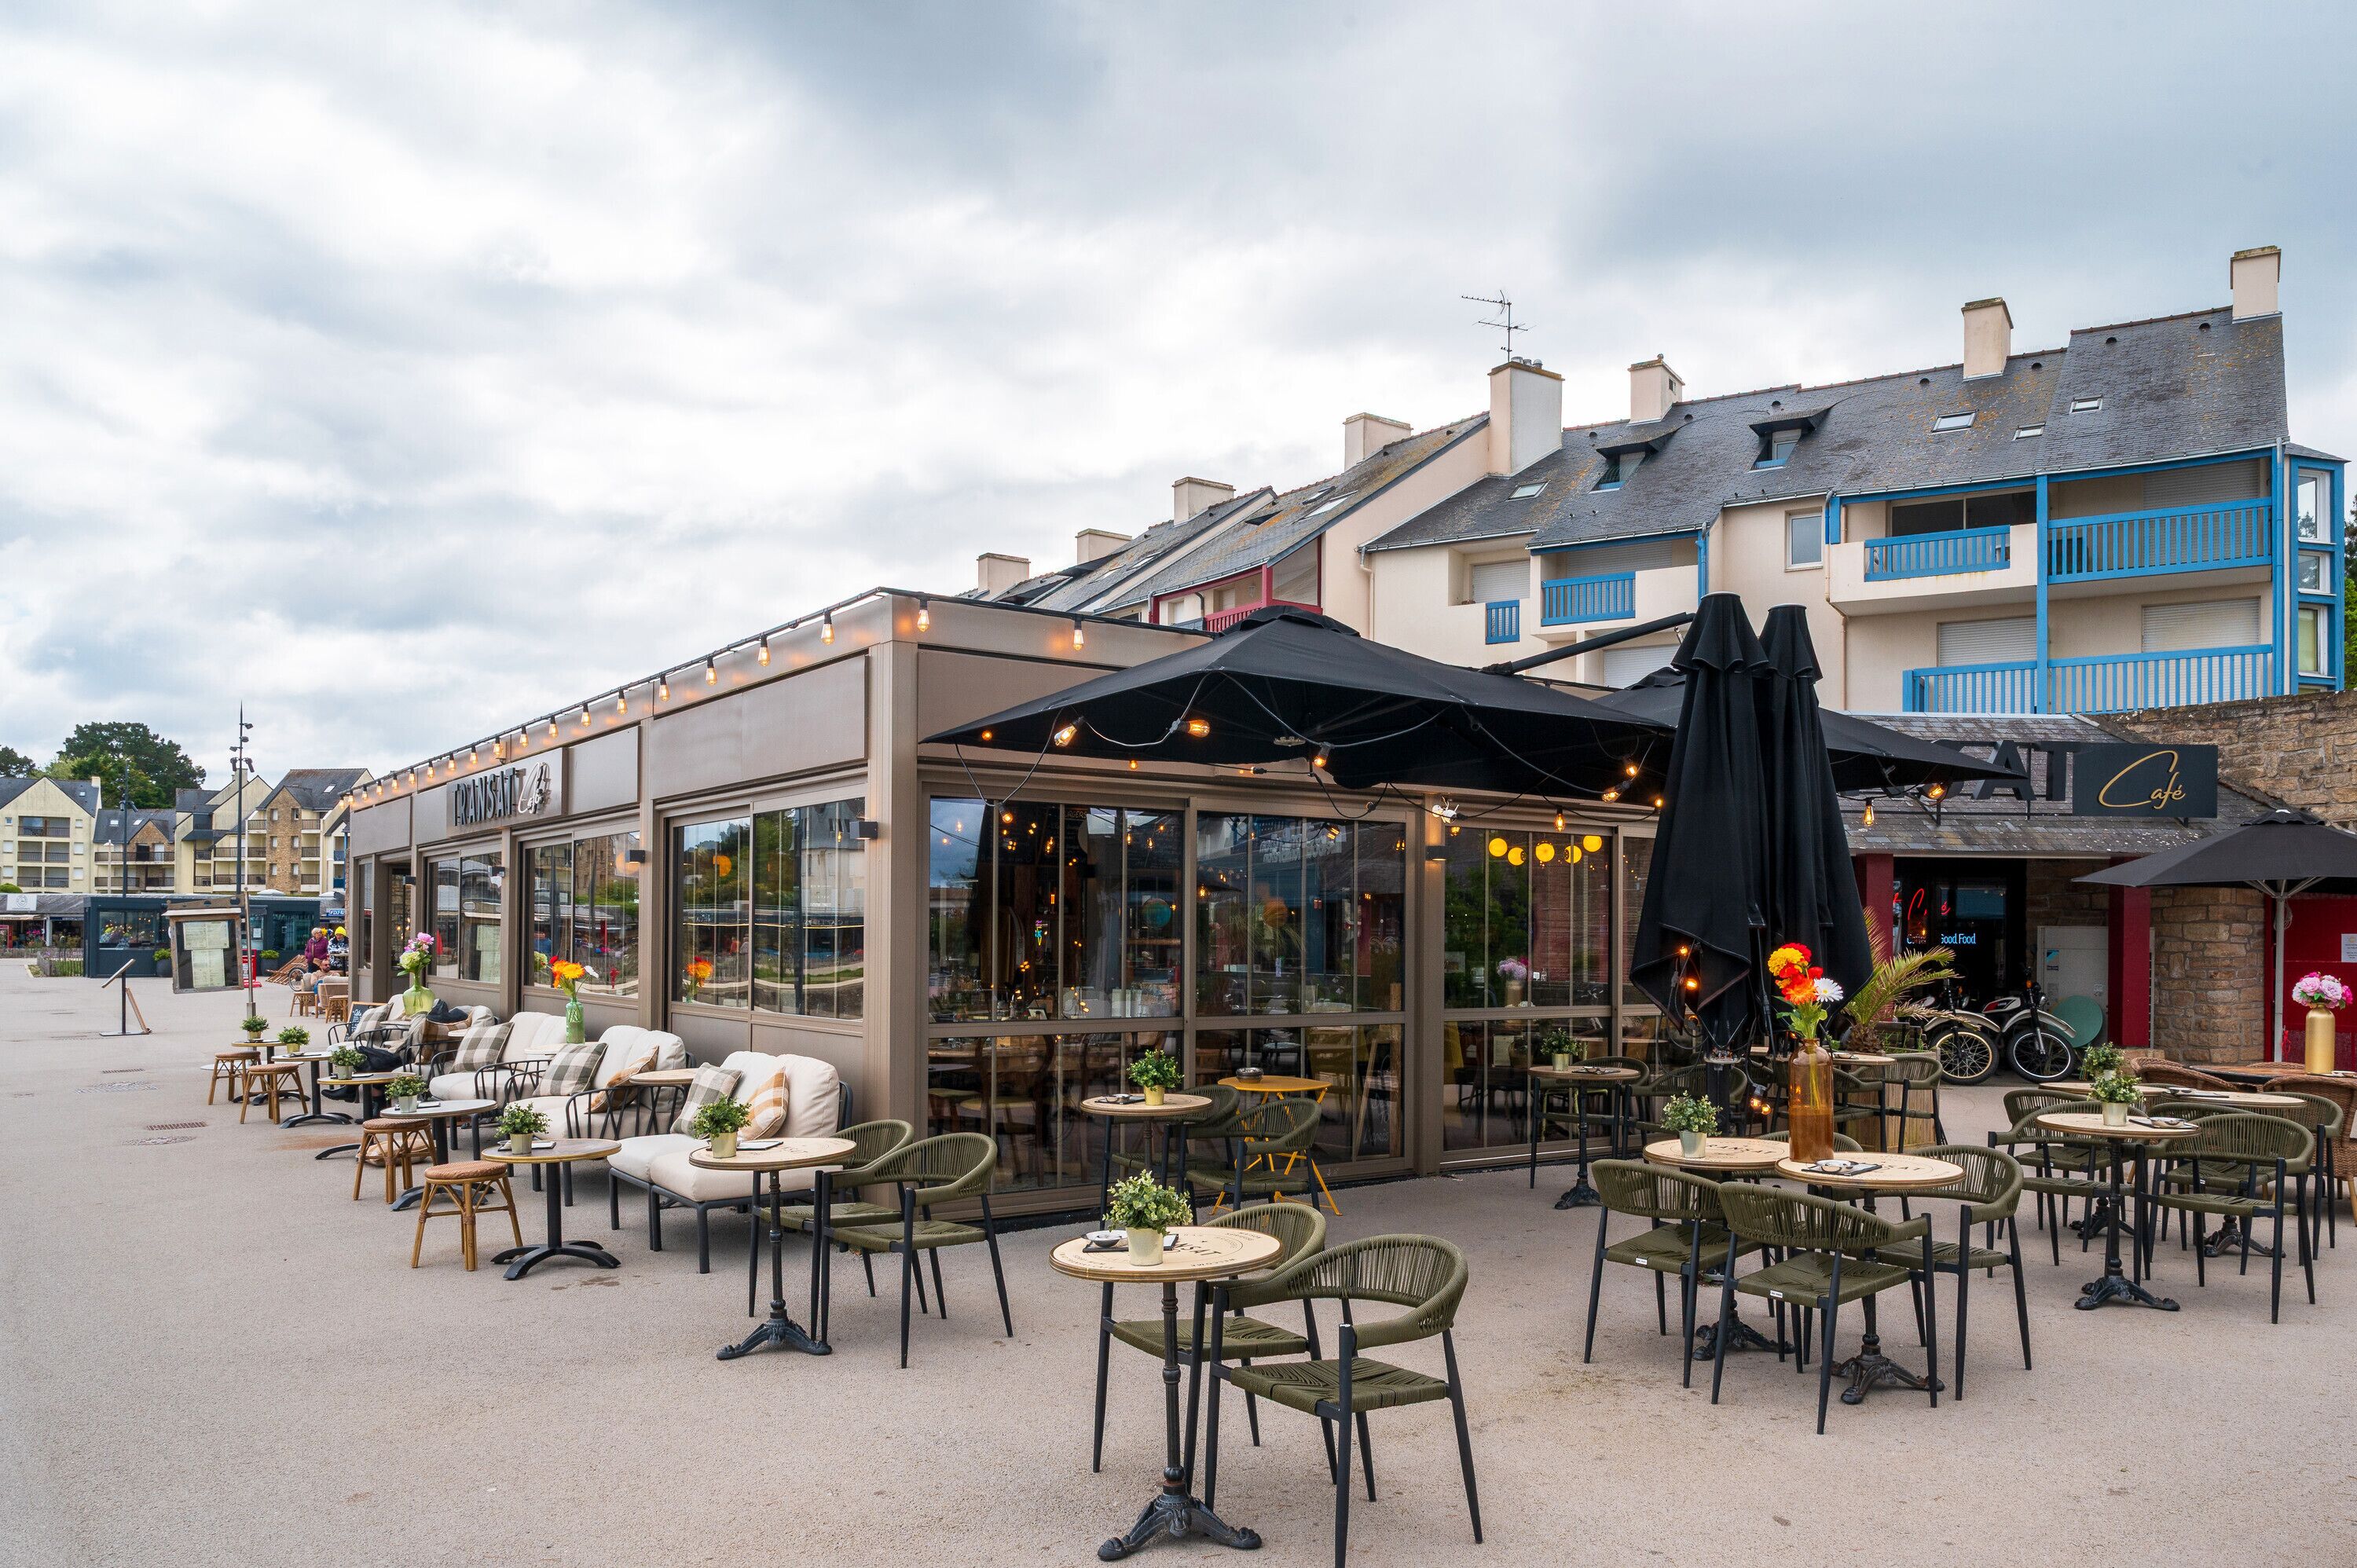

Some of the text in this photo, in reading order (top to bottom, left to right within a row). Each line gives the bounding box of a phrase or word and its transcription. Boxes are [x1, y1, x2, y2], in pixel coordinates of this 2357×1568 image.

[2099, 749, 2186, 809] Café
[453, 768, 515, 826] TRANSAT
[1959, 932, 1976, 943] Food
[1706, 1144, 1776, 1154] RANSAT
